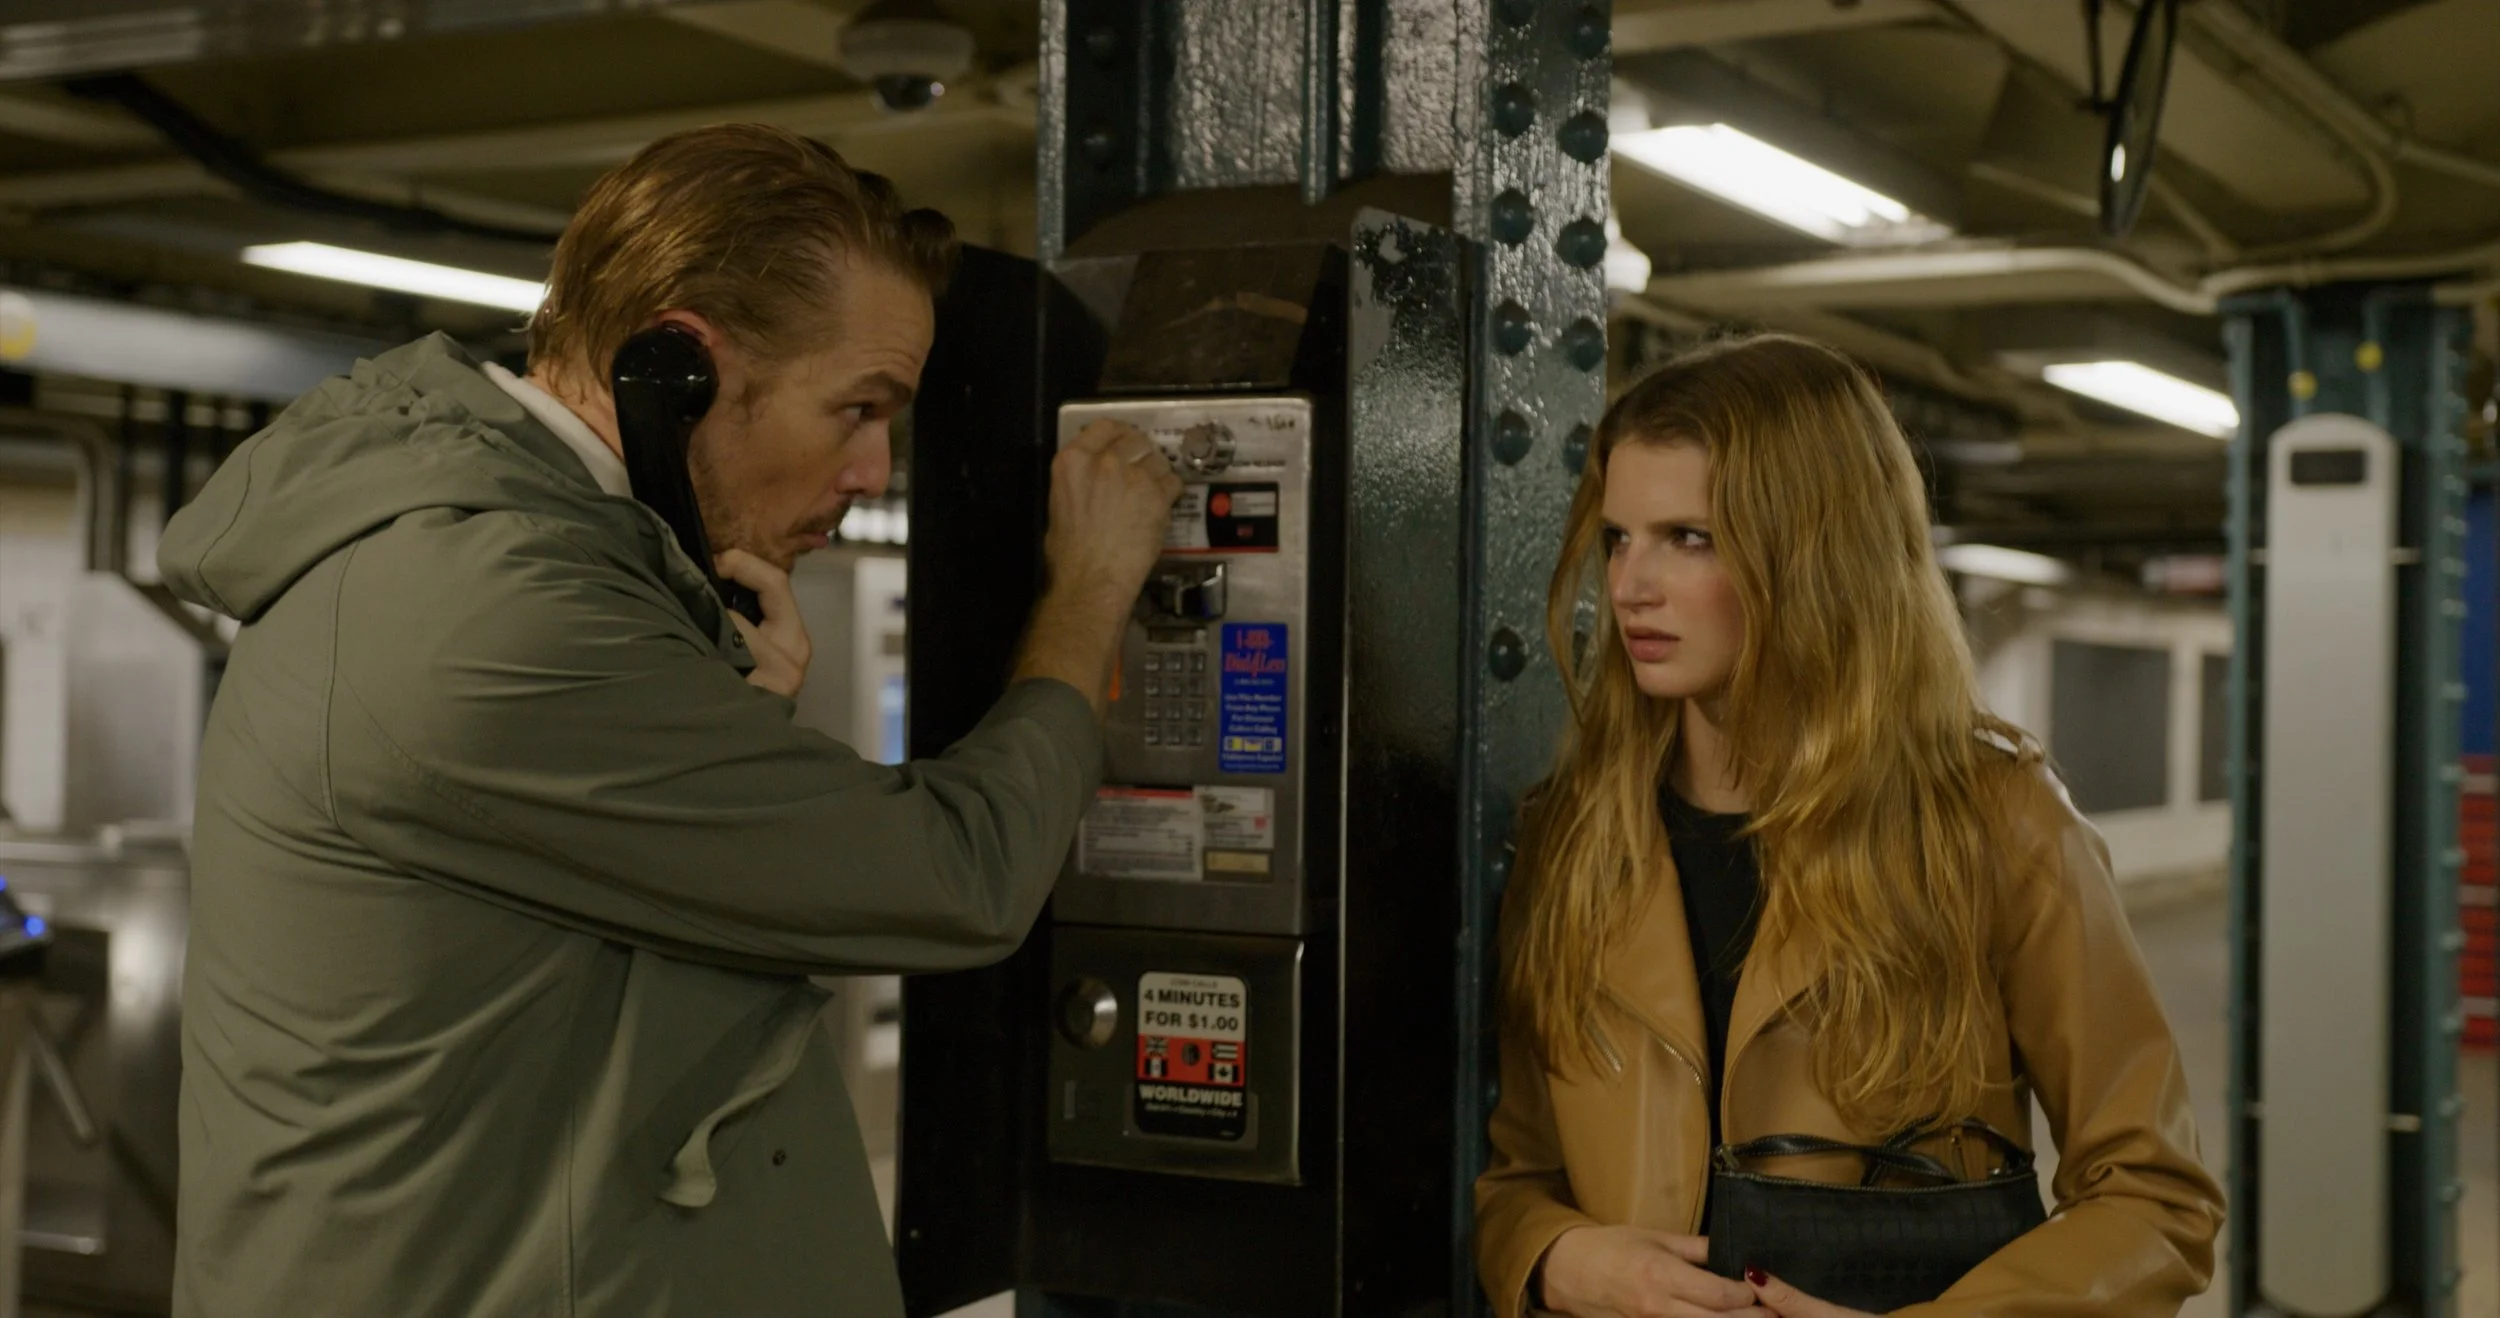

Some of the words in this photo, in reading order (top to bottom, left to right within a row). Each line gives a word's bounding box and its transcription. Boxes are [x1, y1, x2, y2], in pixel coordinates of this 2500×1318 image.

[1143, 989, 1154, 1003] 4
[1158, 989, 1241, 1008] MINUTES
[1144, 1010, 1182, 1028] FOR
[1188, 1012, 1239, 1031] $1.00
[1138, 1084, 1244, 1108] WORLDWIDE
